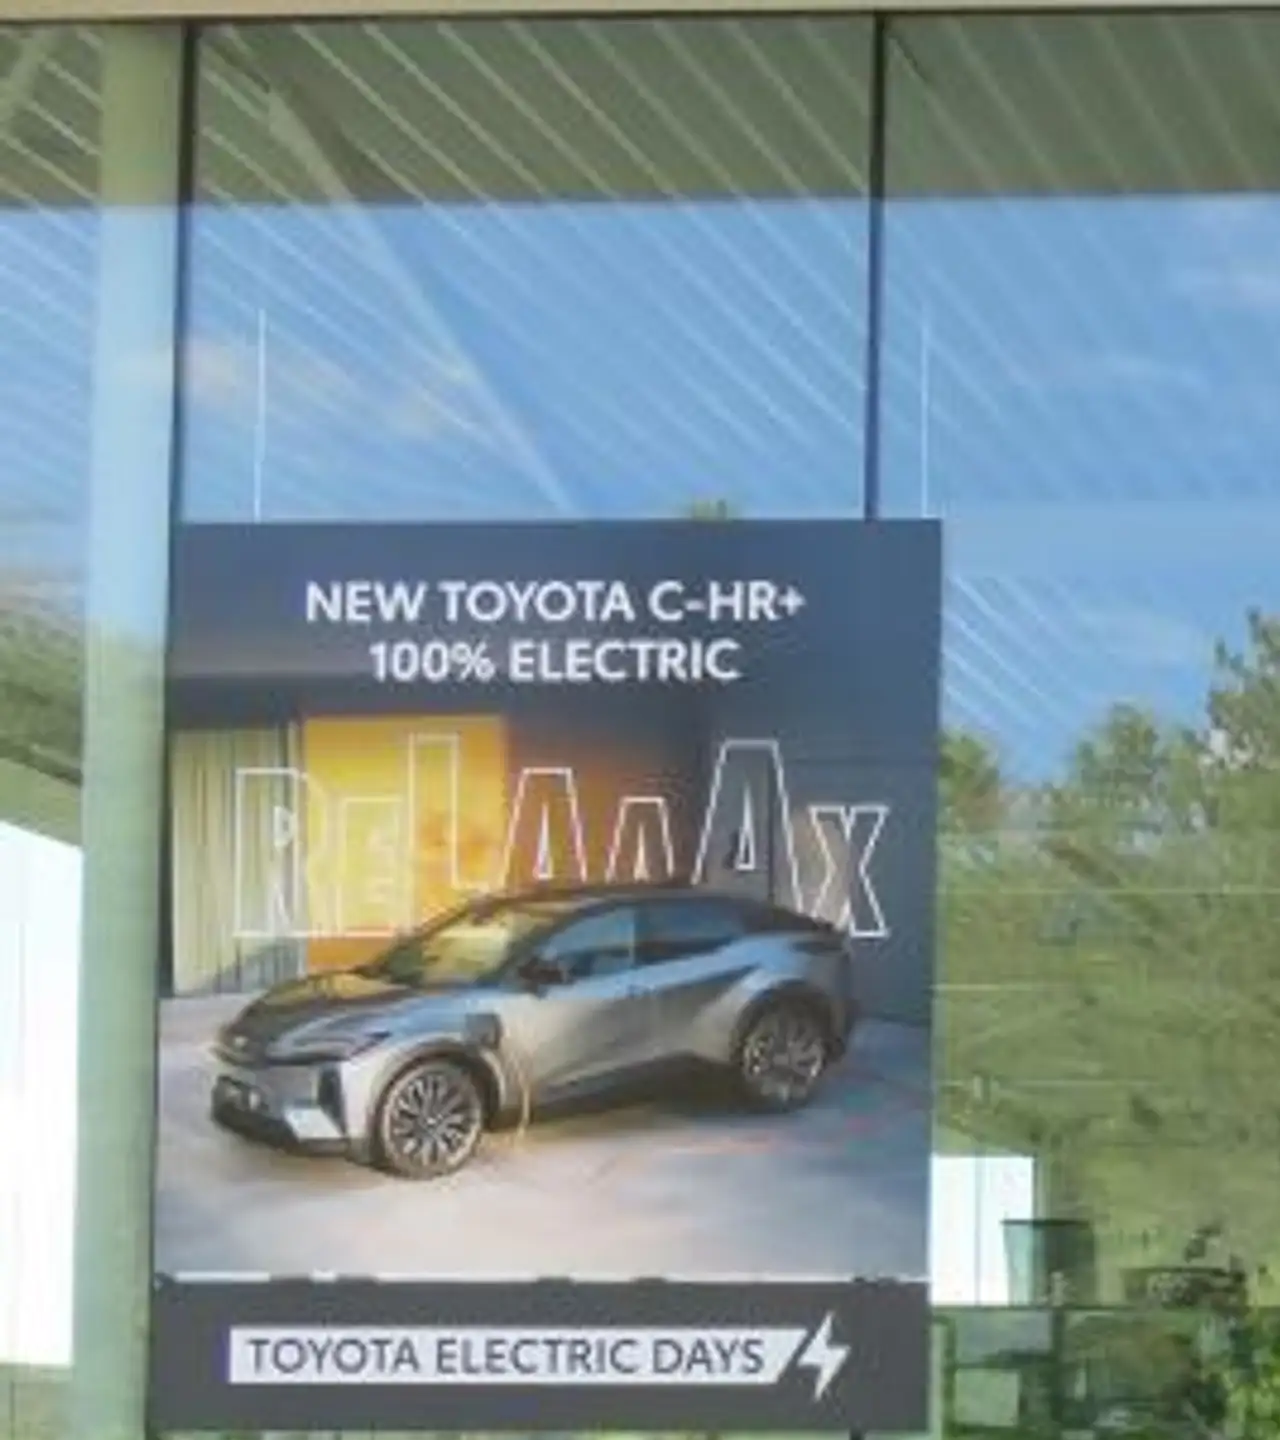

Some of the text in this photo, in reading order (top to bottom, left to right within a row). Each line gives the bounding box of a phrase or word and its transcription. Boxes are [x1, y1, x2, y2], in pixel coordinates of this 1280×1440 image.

[306, 579, 806, 622] NEW TOYOTA C-HR+
[368, 638, 743, 683] 100% ELECTRIC
[248, 1337, 765, 1375] TOYOTA ELECTRIC DAYS
